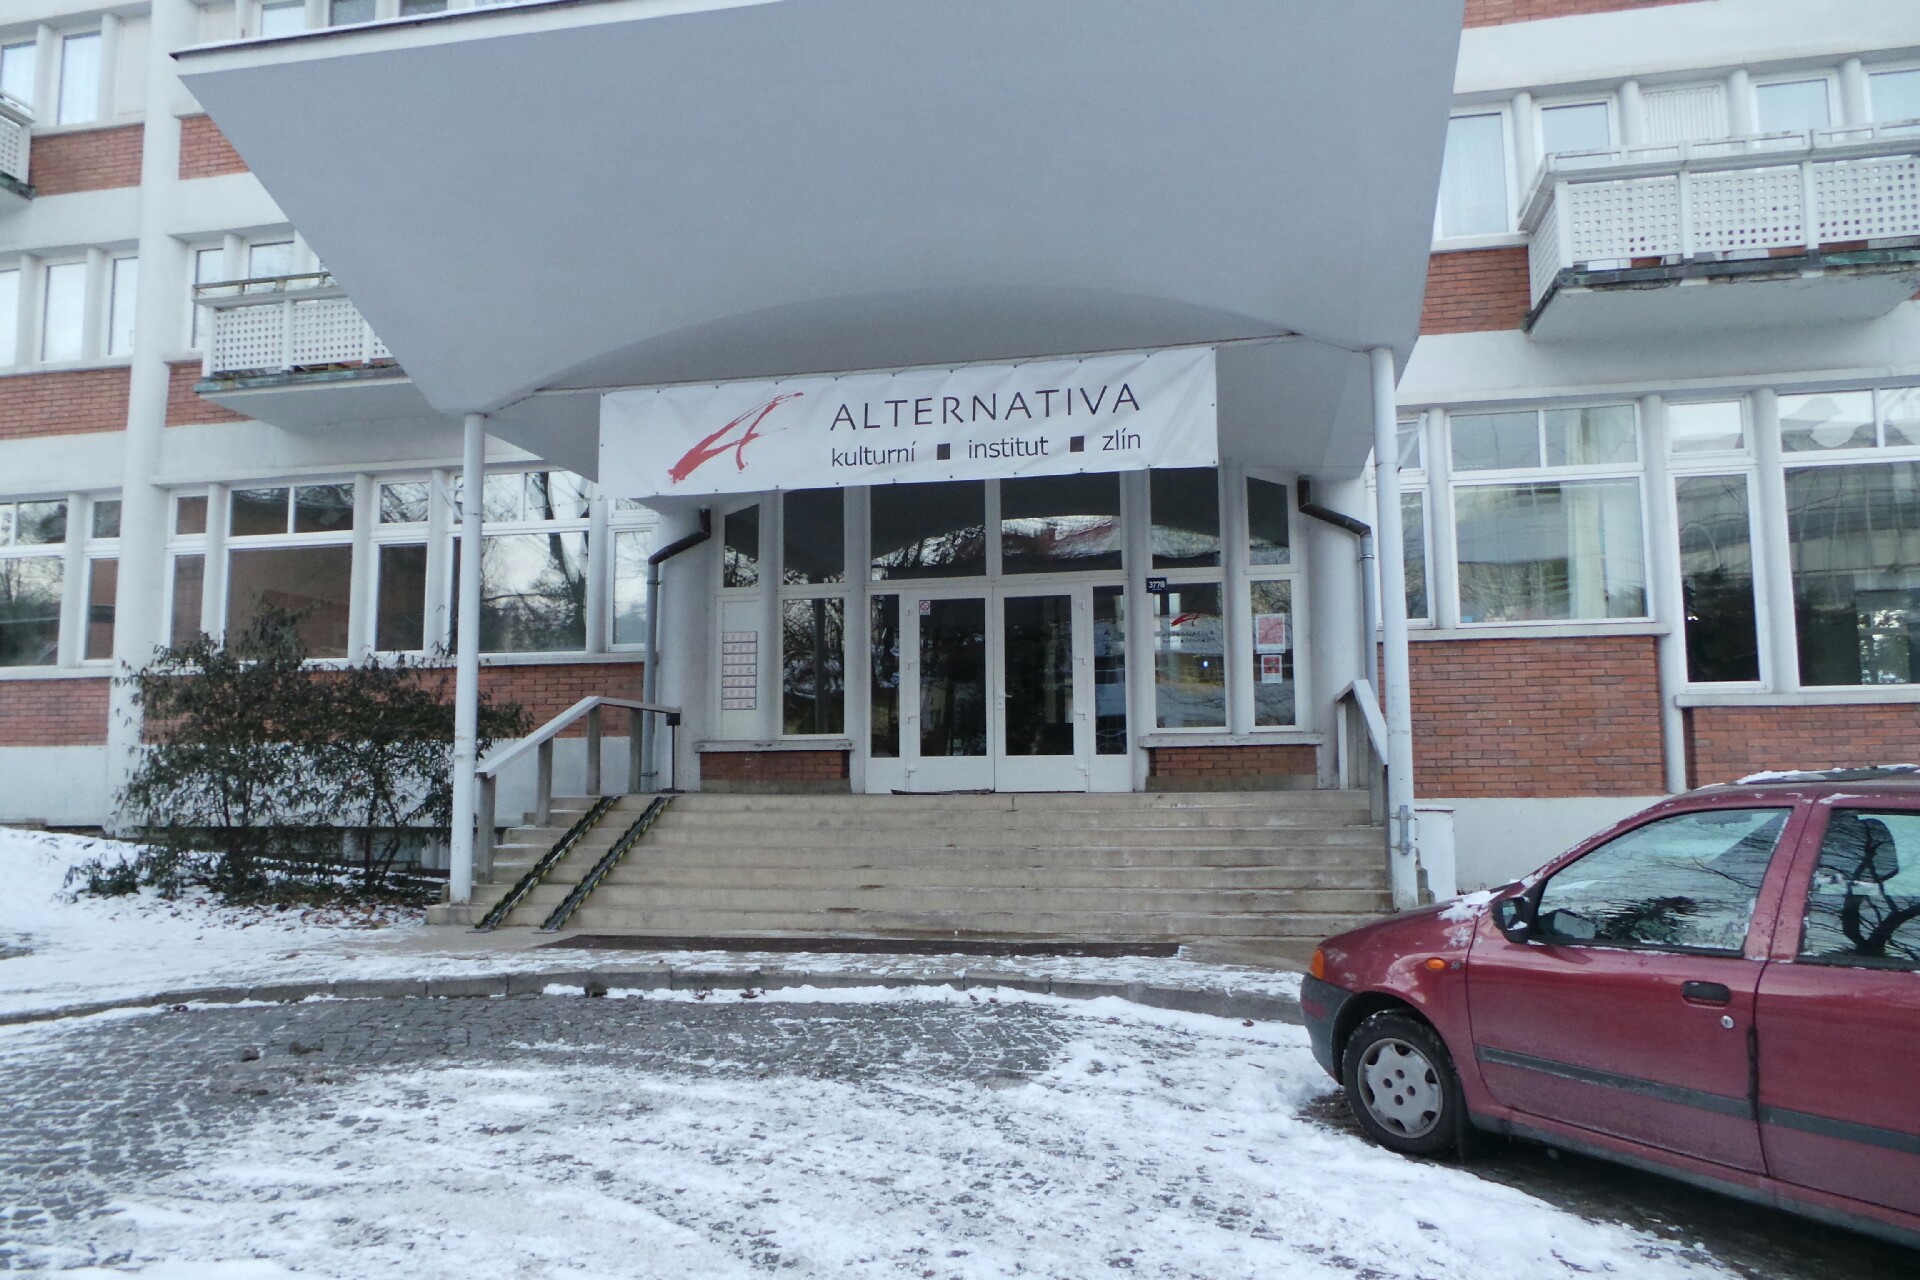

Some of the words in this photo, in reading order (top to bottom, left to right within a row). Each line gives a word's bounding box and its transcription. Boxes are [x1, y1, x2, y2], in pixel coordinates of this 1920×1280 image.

[829, 383, 1140, 431] ALTERNATIVA
[831, 440, 916, 467] kulturní
[968, 436, 1049, 460] institut
[1102, 427, 1141, 451] zlín
[1148, 580, 1166, 589] 3778
